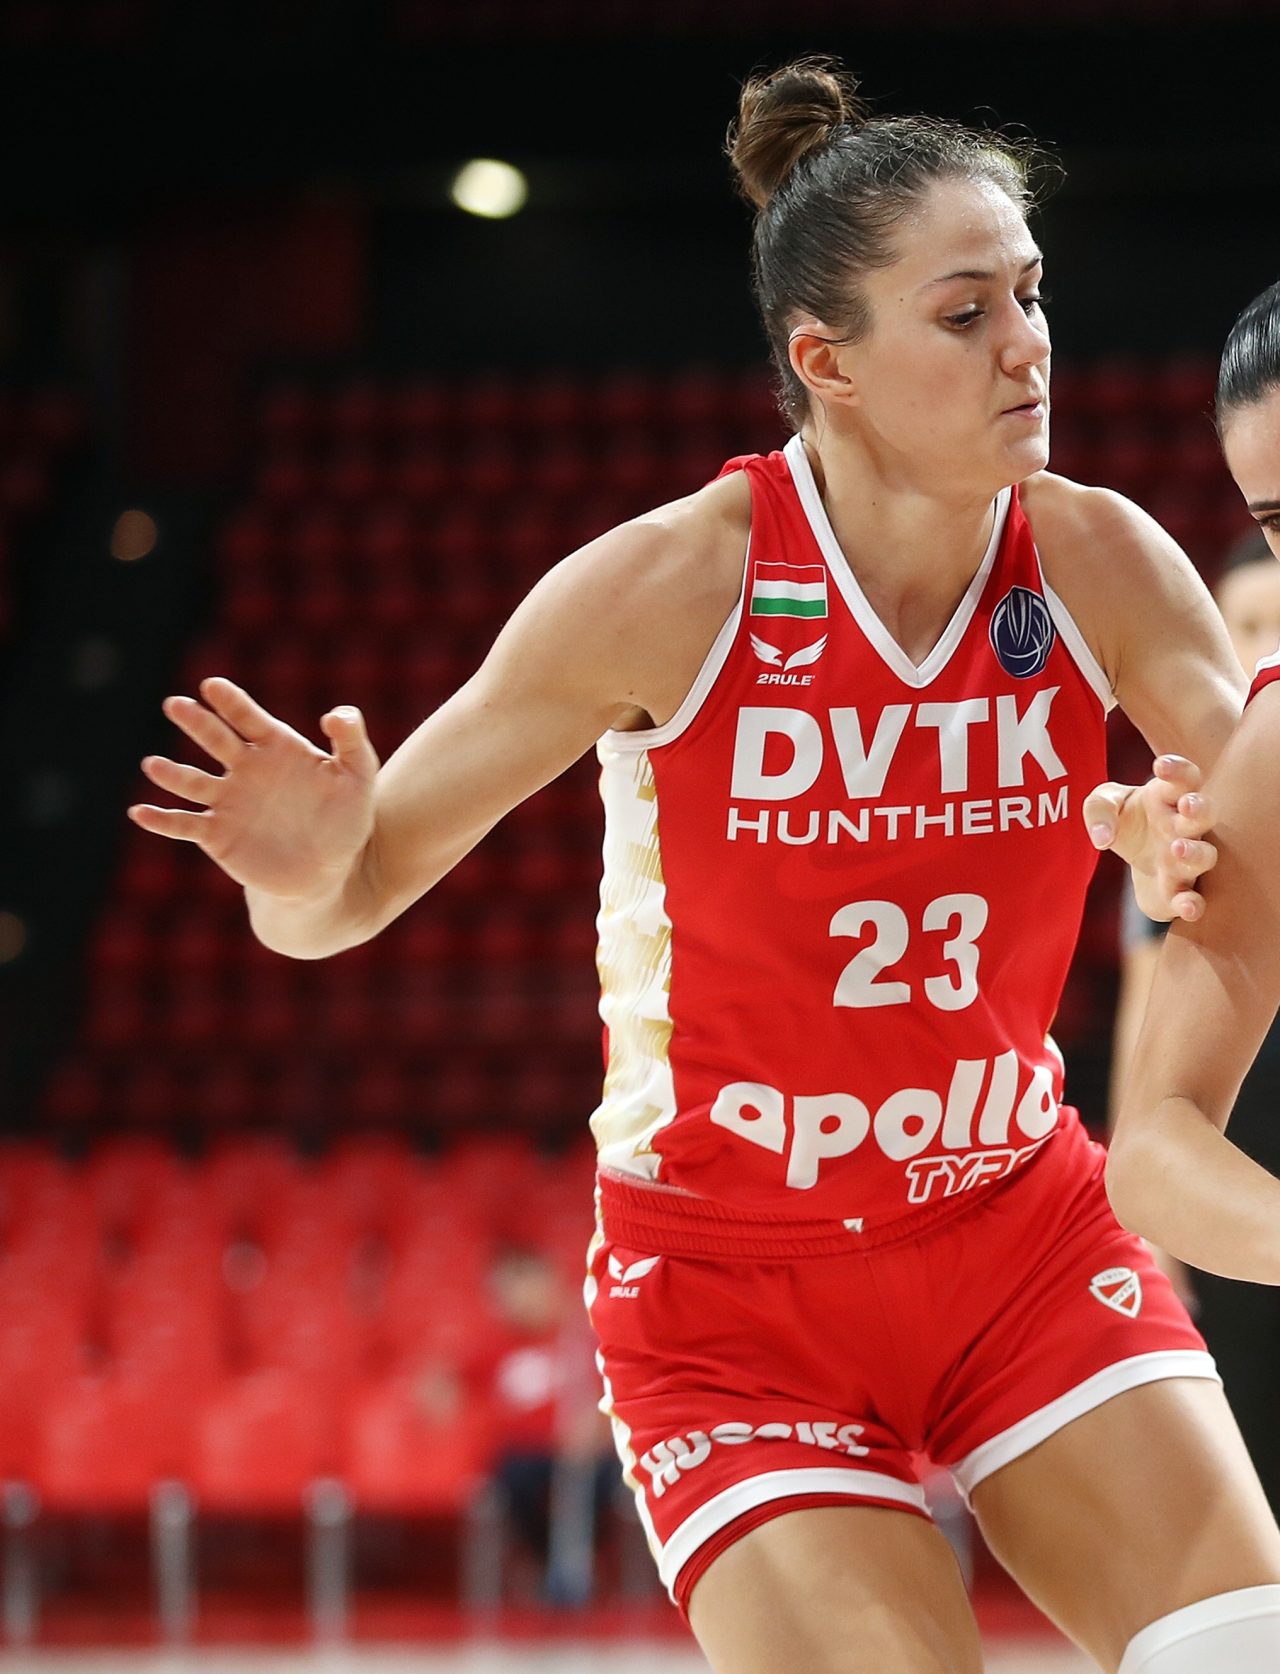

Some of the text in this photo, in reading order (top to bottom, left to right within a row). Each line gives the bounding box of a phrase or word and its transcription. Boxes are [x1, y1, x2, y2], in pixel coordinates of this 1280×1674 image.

[756, 673, 813, 686] 2RULE
[729, 686, 1068, 800] DVTK
[726, 786, 1069, 845] HUNTHERM
[829, 893, 989, 1011] 23
[710, 1048, 1059, 1189] apollo
[905, 1128, 1061, 1204] TYR
